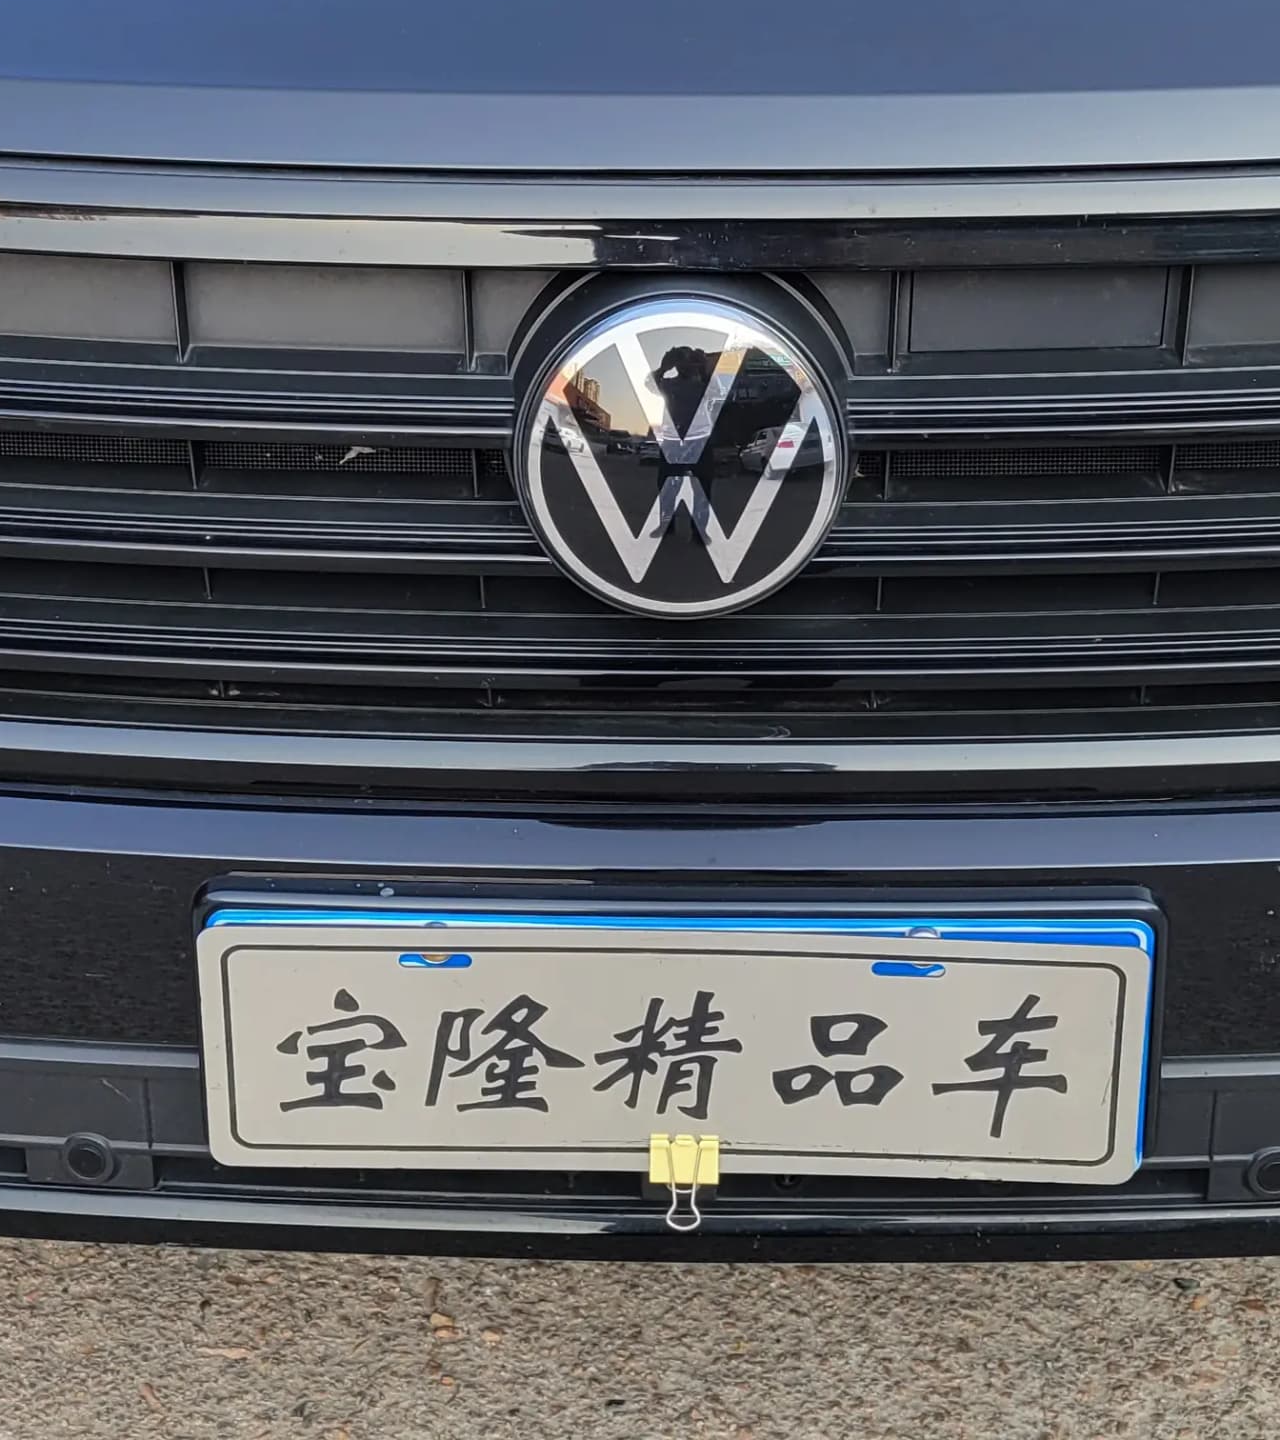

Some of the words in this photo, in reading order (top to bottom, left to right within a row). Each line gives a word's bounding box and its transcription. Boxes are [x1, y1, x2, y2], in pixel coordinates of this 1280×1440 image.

[276, 988, 1068, 1139] 宝隆精品车
